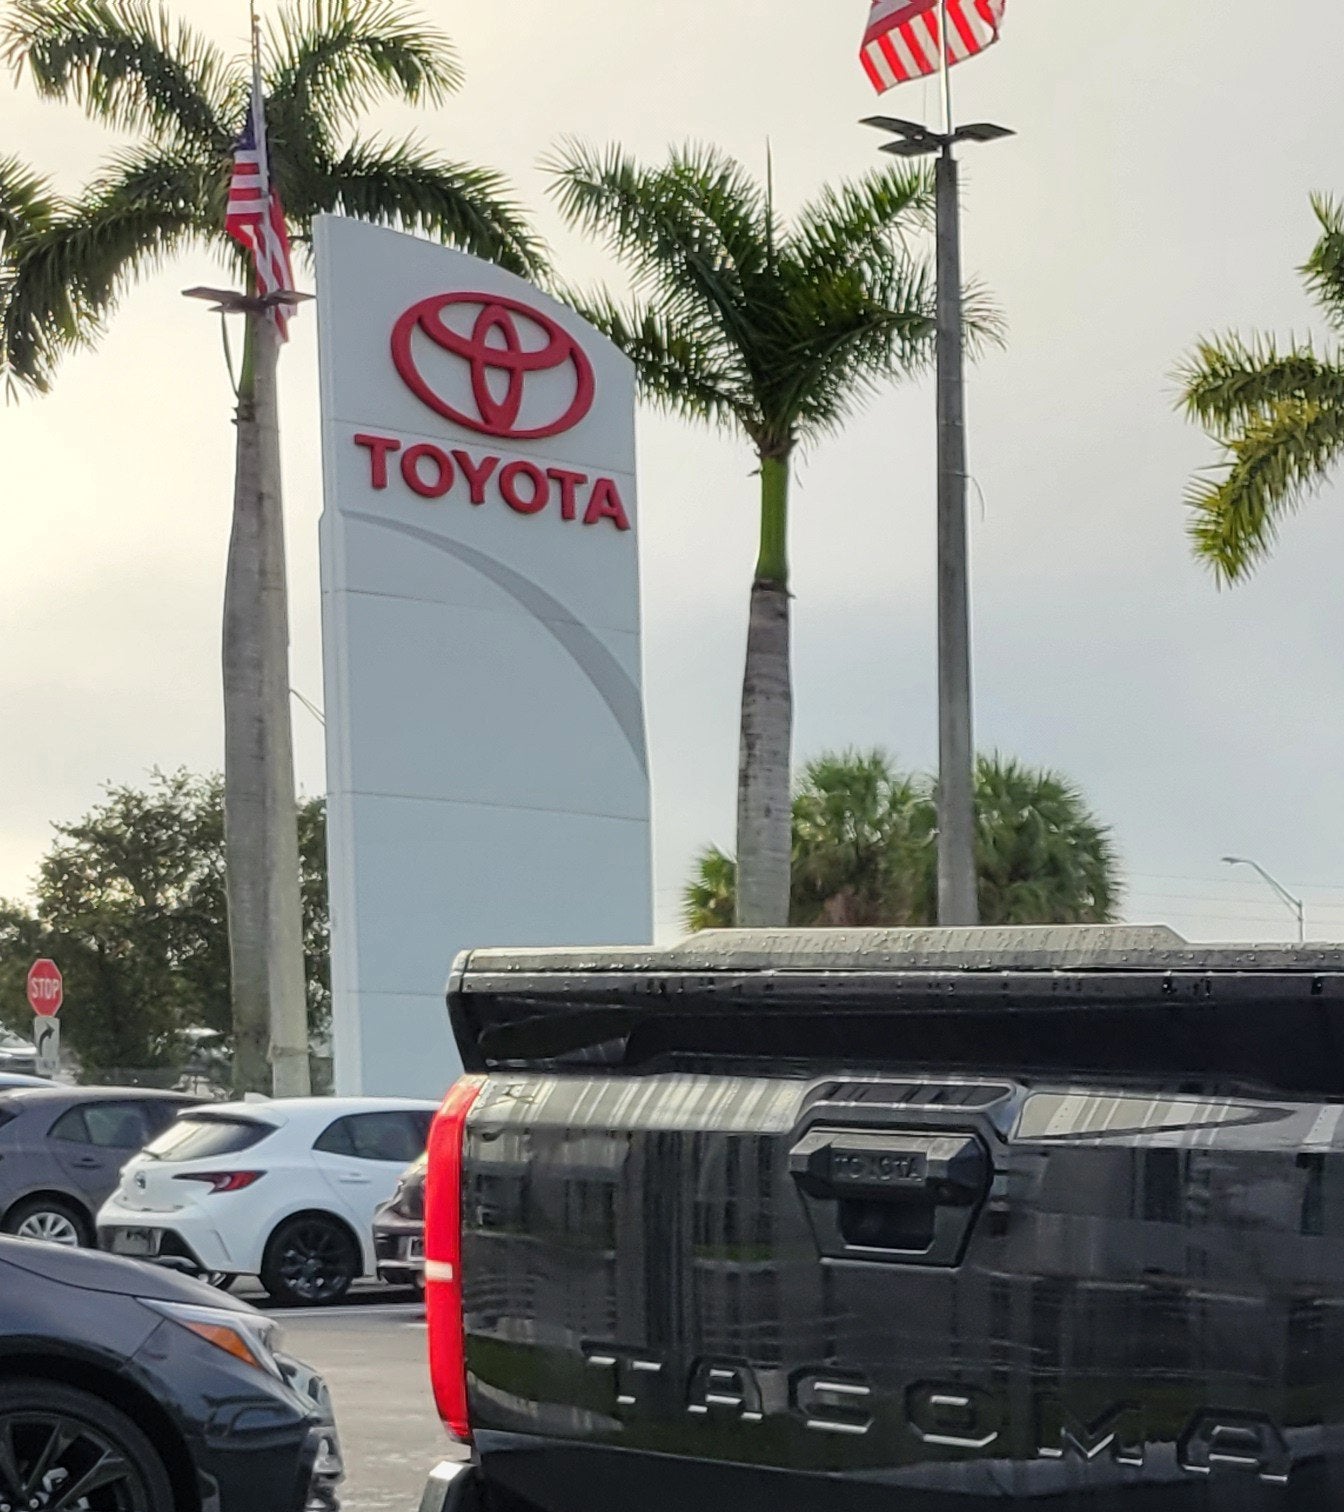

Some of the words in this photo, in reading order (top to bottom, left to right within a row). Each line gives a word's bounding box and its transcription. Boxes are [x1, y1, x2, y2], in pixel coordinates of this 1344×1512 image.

[354, 433, 631, 531] TOYOTA
[31, 977, 60, 1000] STOP
[580, 1340, 1288, 1483] TACOMA
